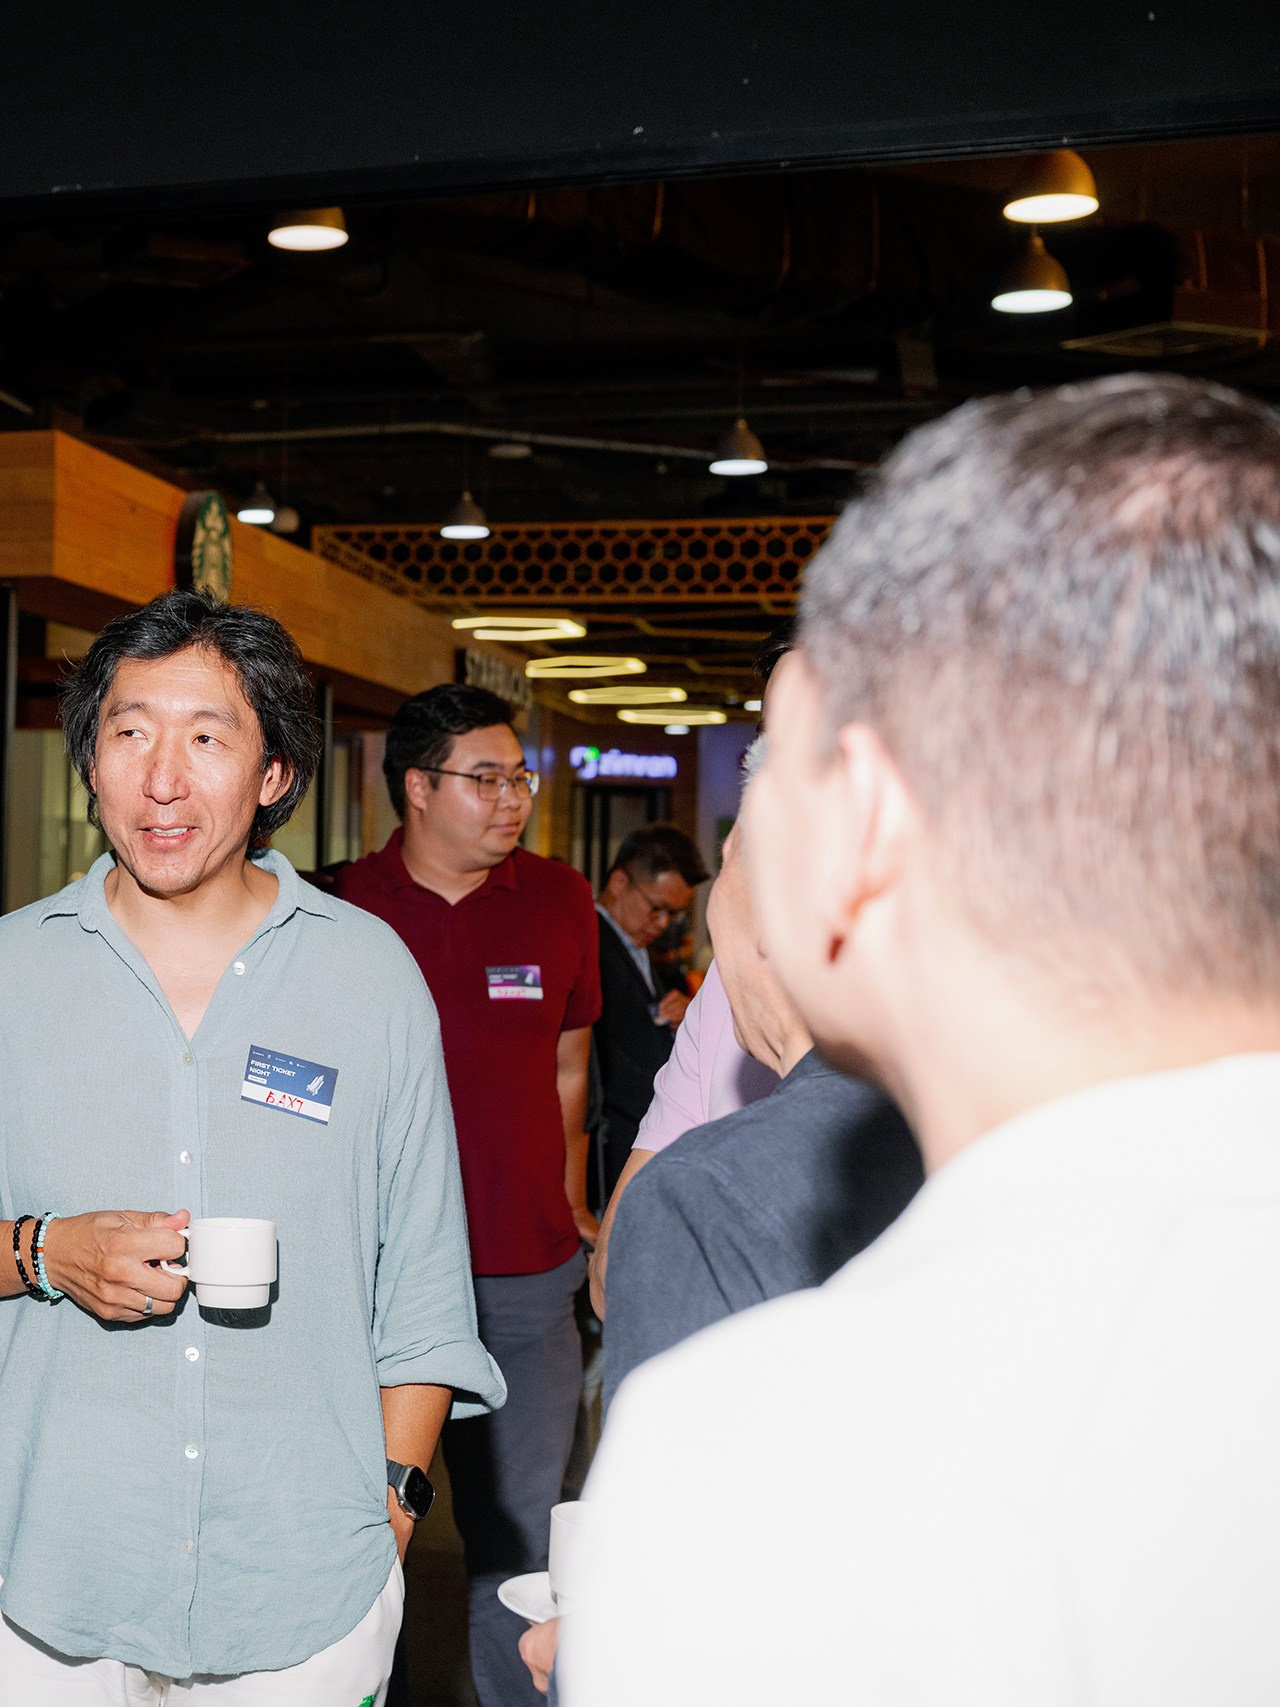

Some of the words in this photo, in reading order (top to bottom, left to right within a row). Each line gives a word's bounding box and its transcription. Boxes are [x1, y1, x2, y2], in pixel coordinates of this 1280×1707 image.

[249, 1067, 271, 1077] NIGHT
[250, 1059, 271, 1070] FIRST
[272, 1065, 297, 1077] TICKET
